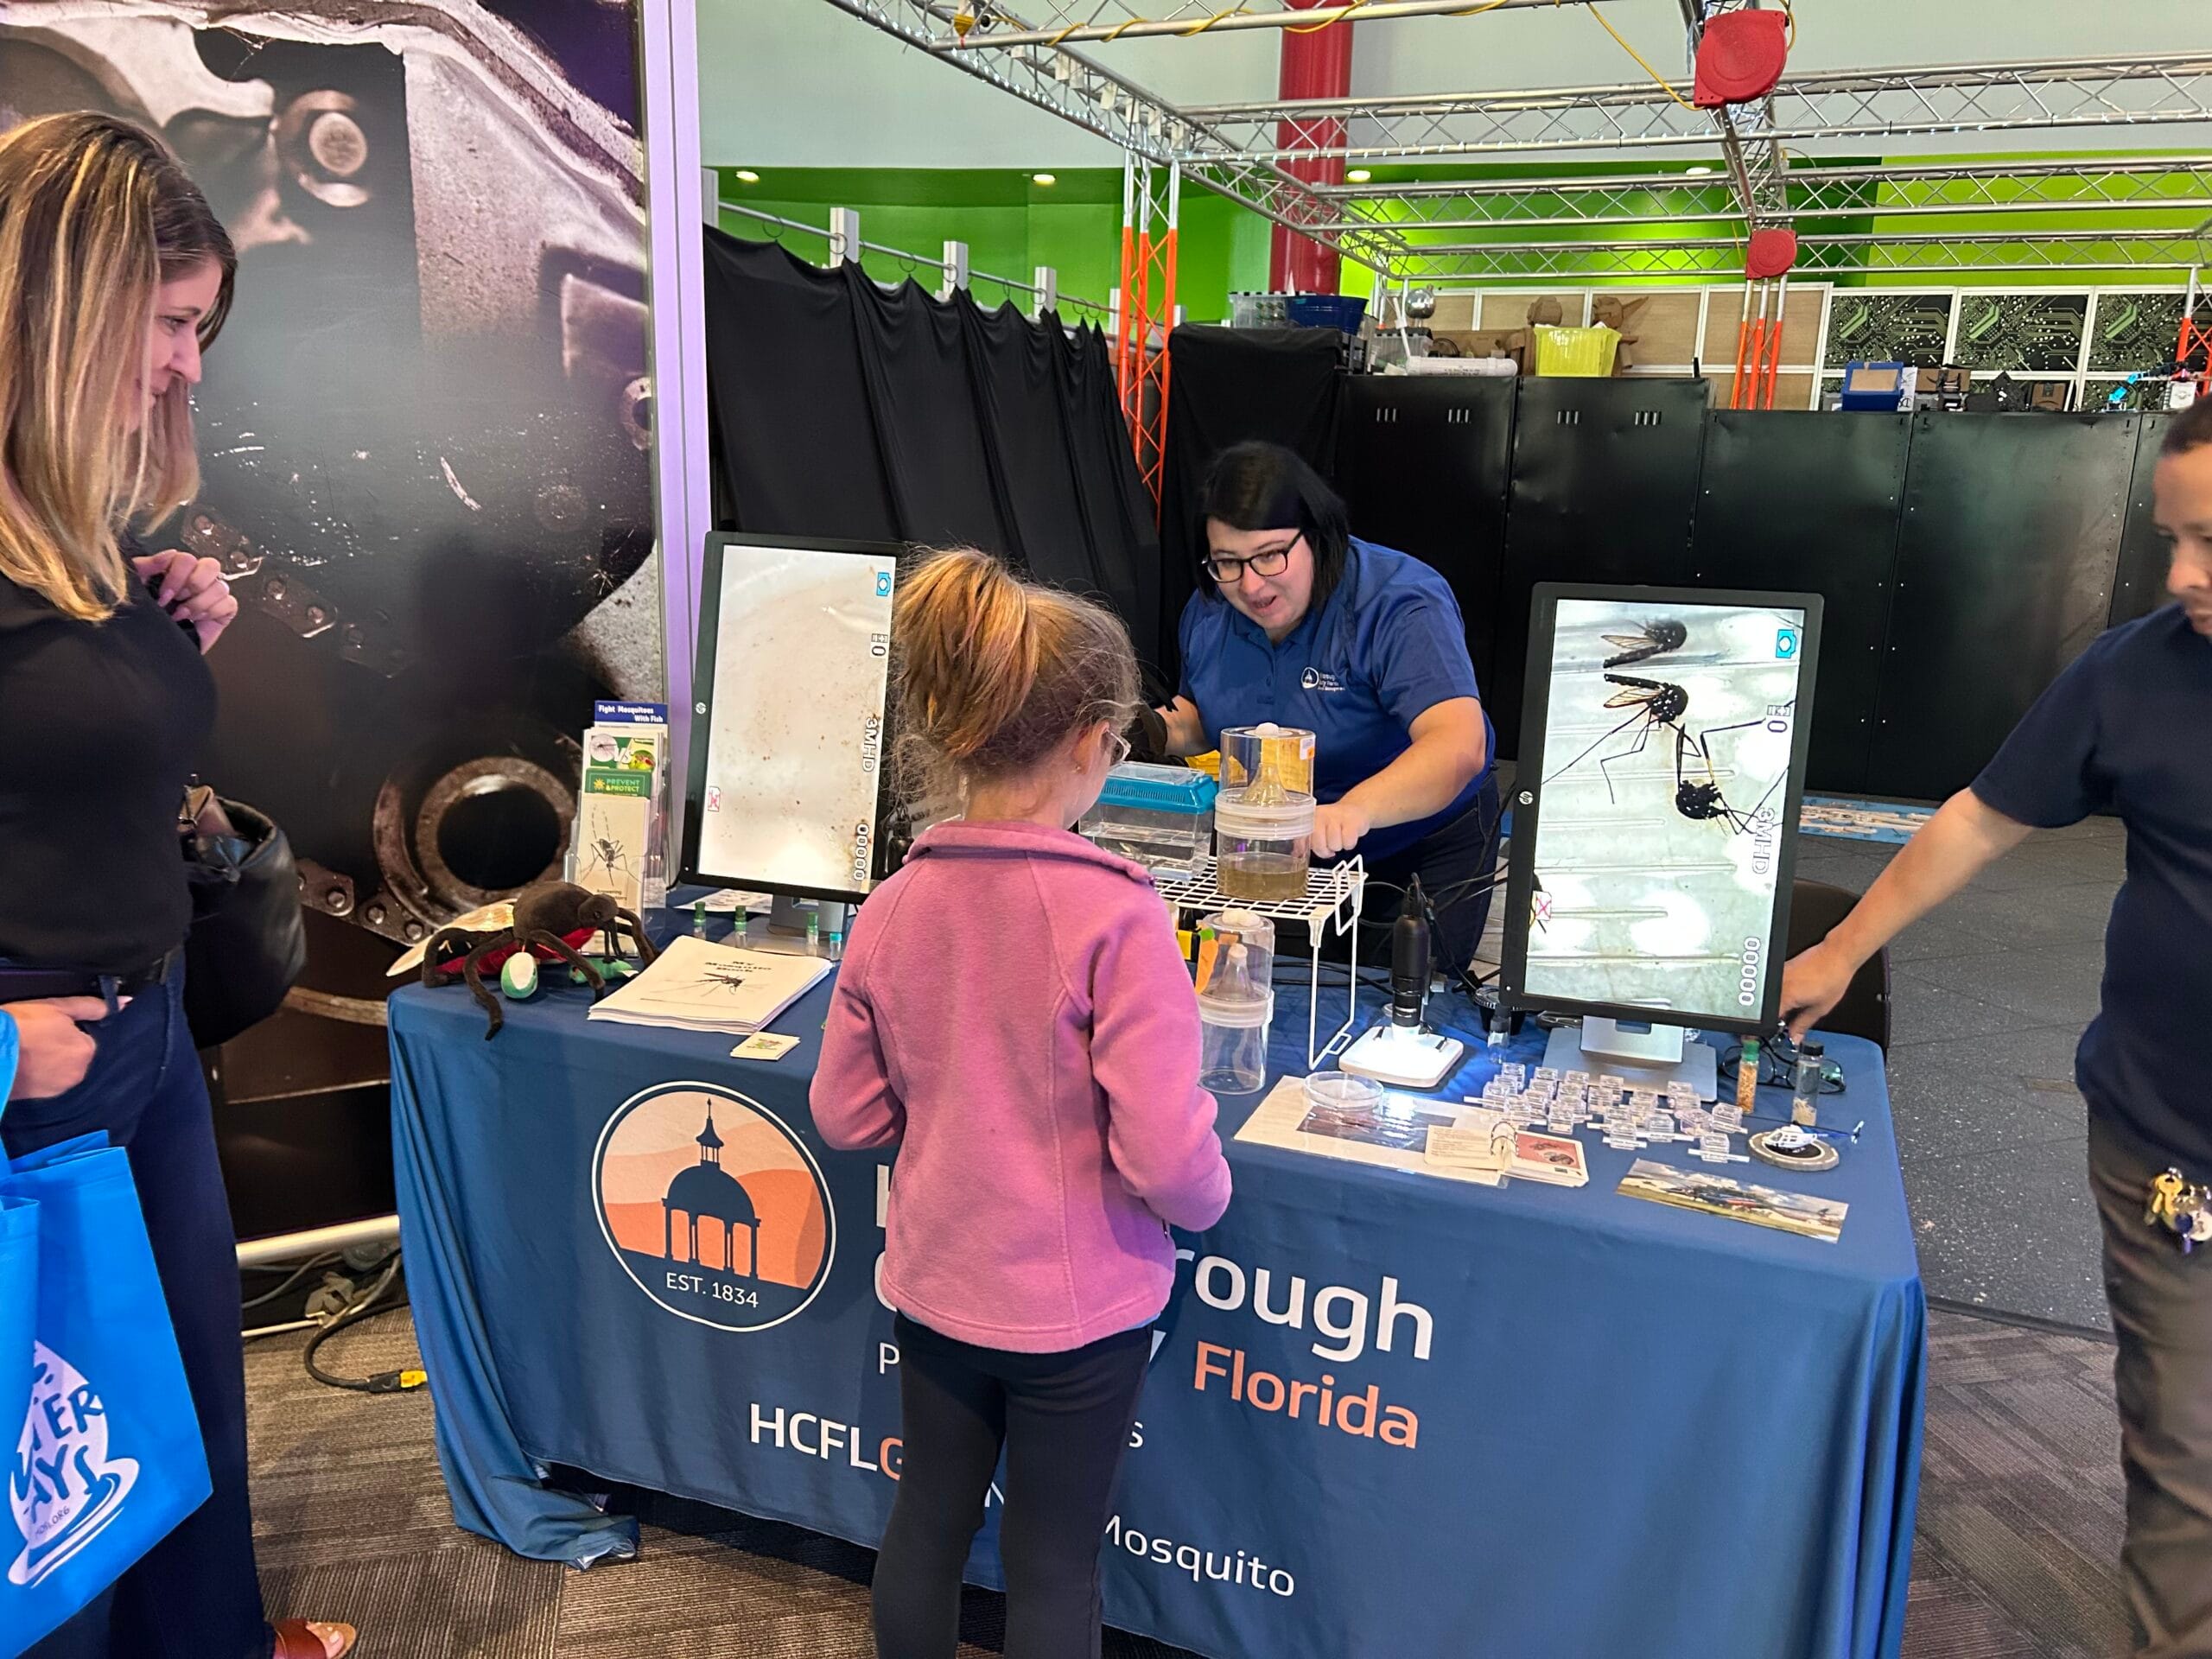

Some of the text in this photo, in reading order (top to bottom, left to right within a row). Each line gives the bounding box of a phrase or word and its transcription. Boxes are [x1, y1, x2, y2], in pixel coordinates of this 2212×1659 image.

[598, 704, 616, 715] Fight
[634, 715, 650, 723] With
[863, 717, 878, 772] 3MHD
[1752, 807, 1776, 875] 3MHD
[666, 1272, 759, 1308] EST. 1834
[1194, 1340, 1419, 1449] Florida
